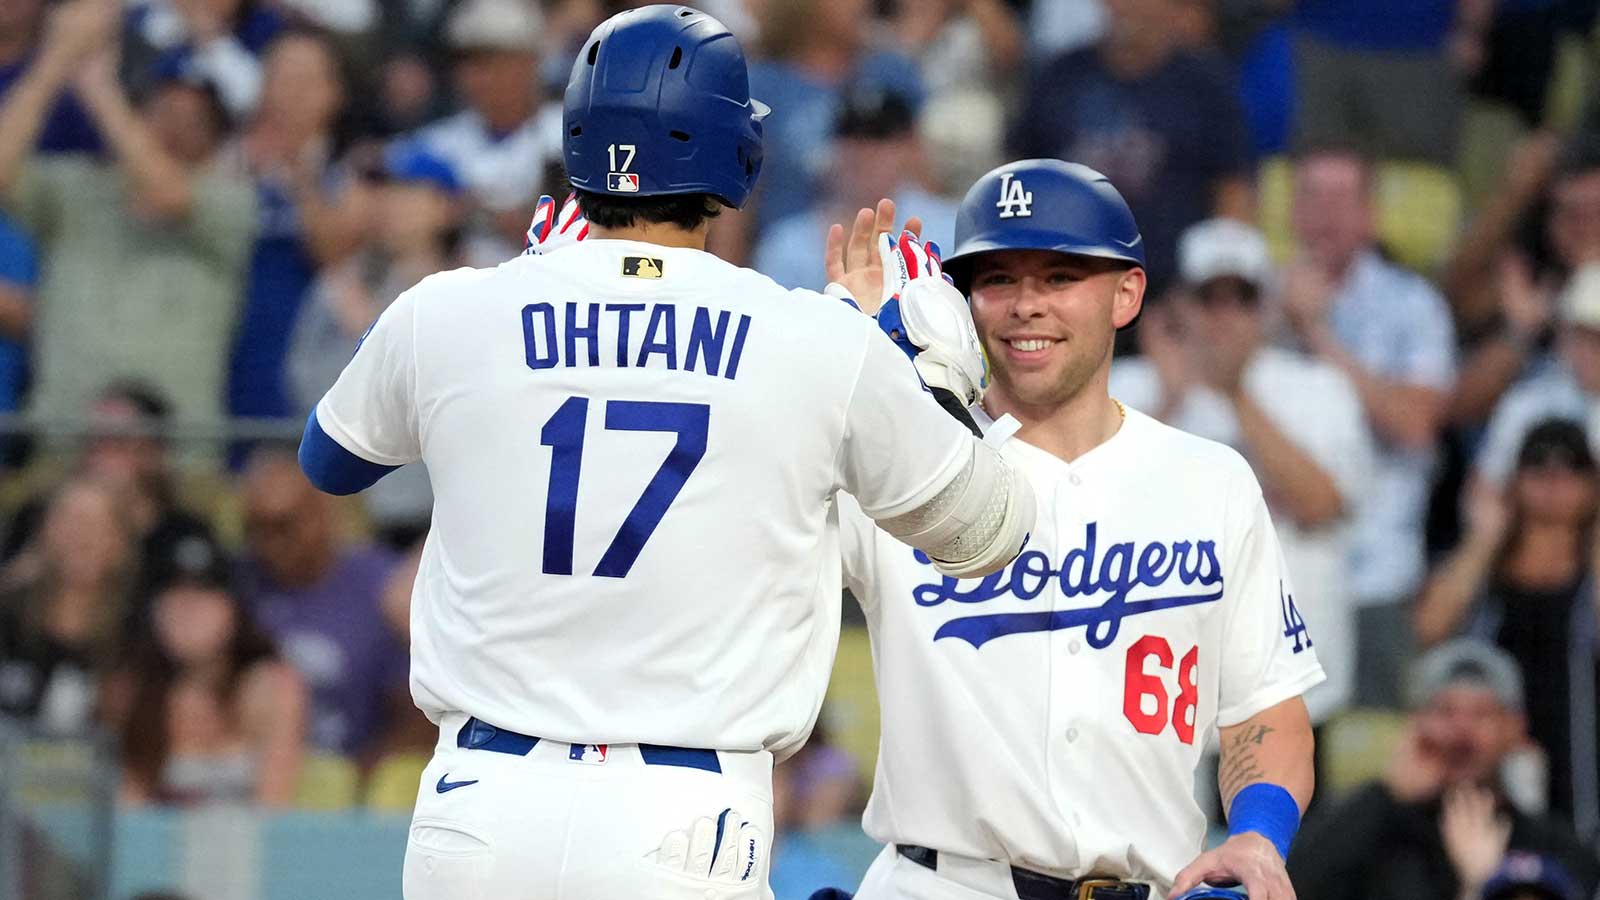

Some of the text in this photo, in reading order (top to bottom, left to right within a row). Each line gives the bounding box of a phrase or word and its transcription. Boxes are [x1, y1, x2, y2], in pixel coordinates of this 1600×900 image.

[608, 144, 636, 172] 17
[996, 173, 1032, 218] LA
[521, 302, 752, 380] OHTANI
[540, 396, 711, 578] 17
[1280, 579, 1313, 654] LA
[1123, 635, 1199, 745] 68
